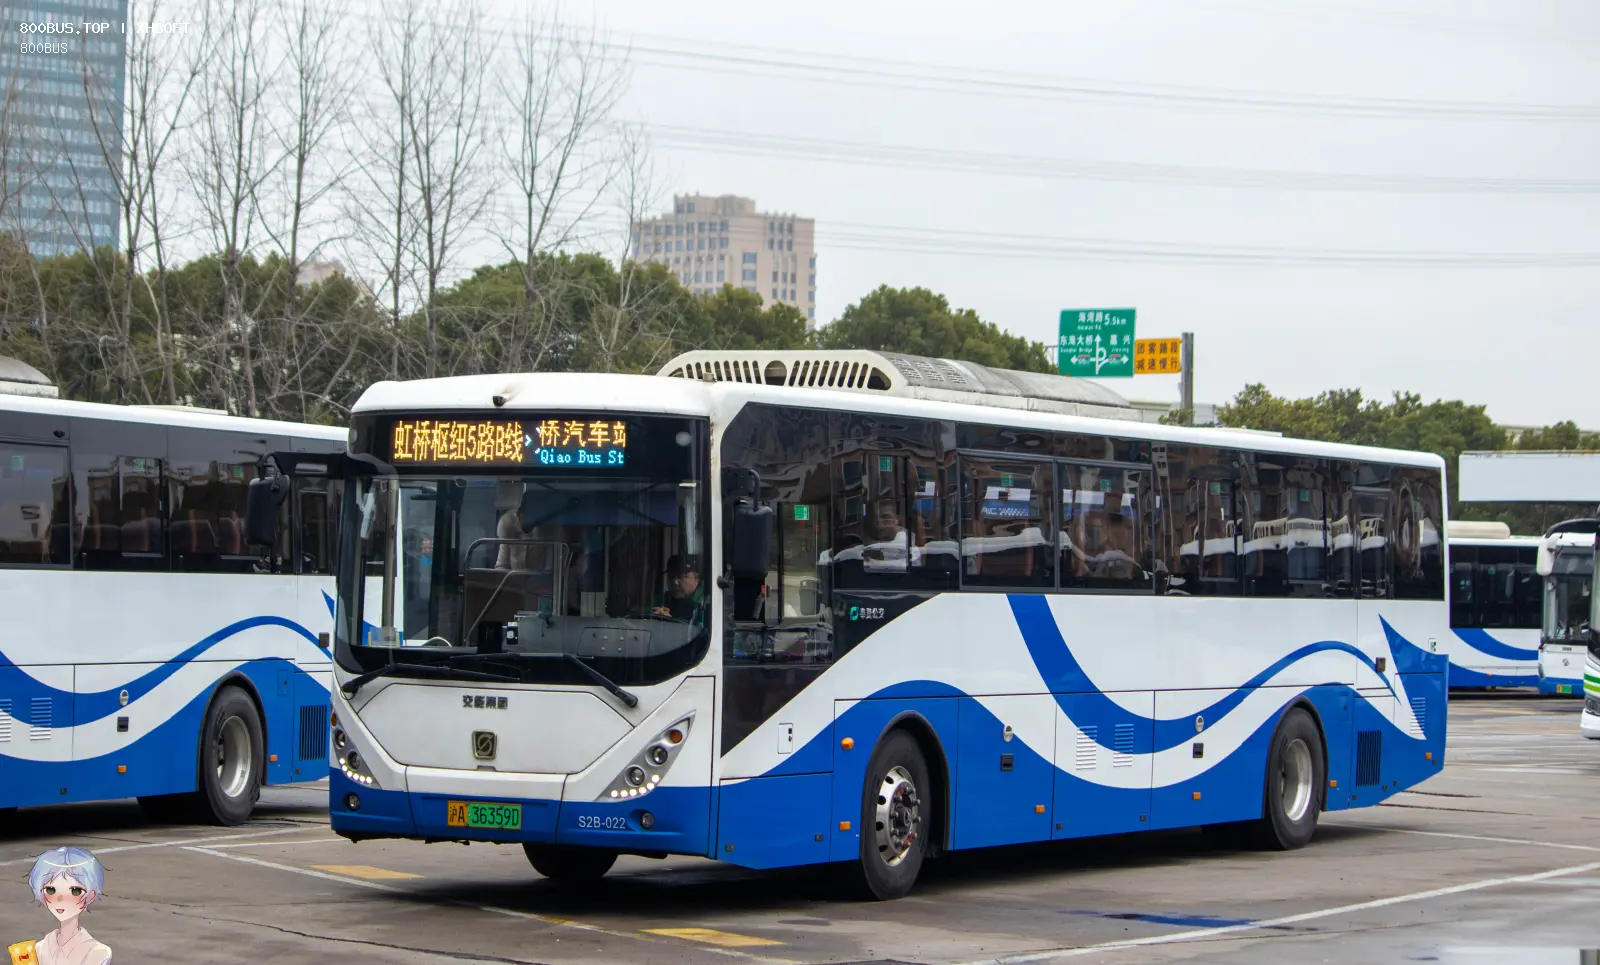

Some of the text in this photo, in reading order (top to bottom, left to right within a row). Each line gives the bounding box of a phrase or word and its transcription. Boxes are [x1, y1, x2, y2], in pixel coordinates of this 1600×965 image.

[1060, 334, 1093, 346] 东海大桥
[1136, 357, 1178, 371] 减速慢行
[393, 420, 524, 462] 虹桥枢纽5路B线
[540, 448, 571, 464] Qiao
[578, 449, 602, 464] Bus
[578, 815, 626, 830] S2B-022
